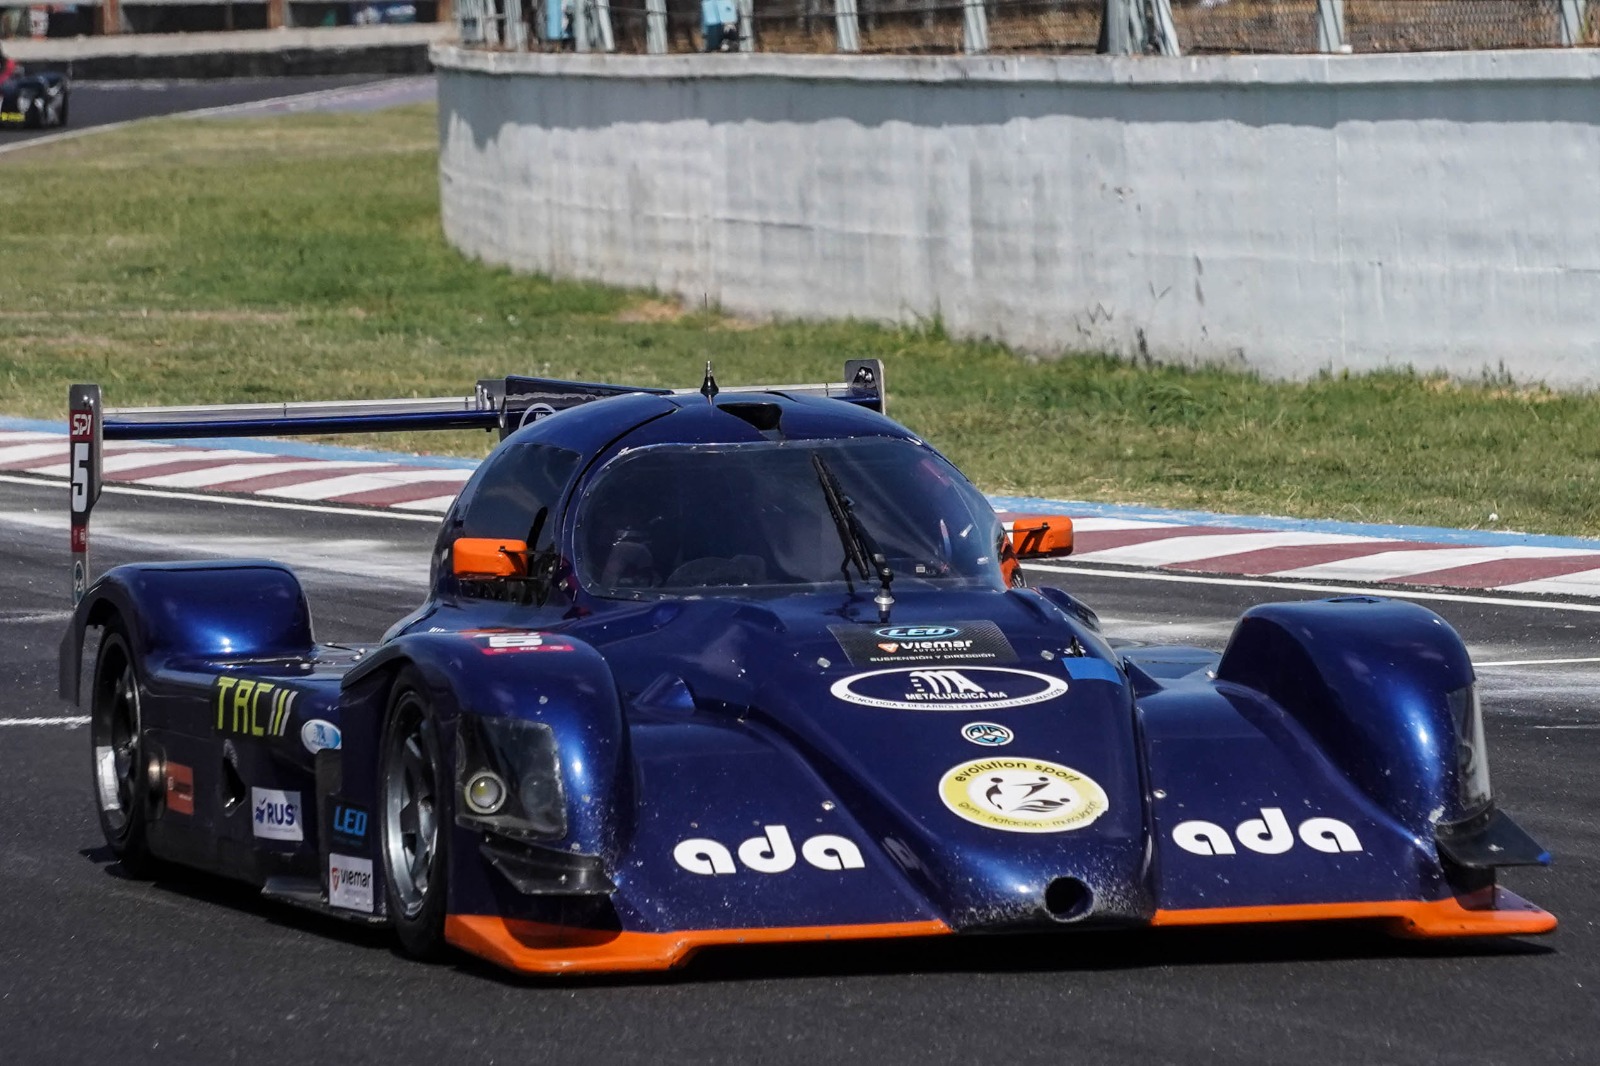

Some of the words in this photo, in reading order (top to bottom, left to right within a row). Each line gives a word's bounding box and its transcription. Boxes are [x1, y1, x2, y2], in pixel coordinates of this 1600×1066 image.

[72, 443, 89, 513] 5
[954, 761, 1027, 782] evolution
[1034, 763, 1081, 782] sport
[267, 802, 295, 826] RUS
[1172, 807, 1364, 856] ada
[673, 825, 865, 875] ada
